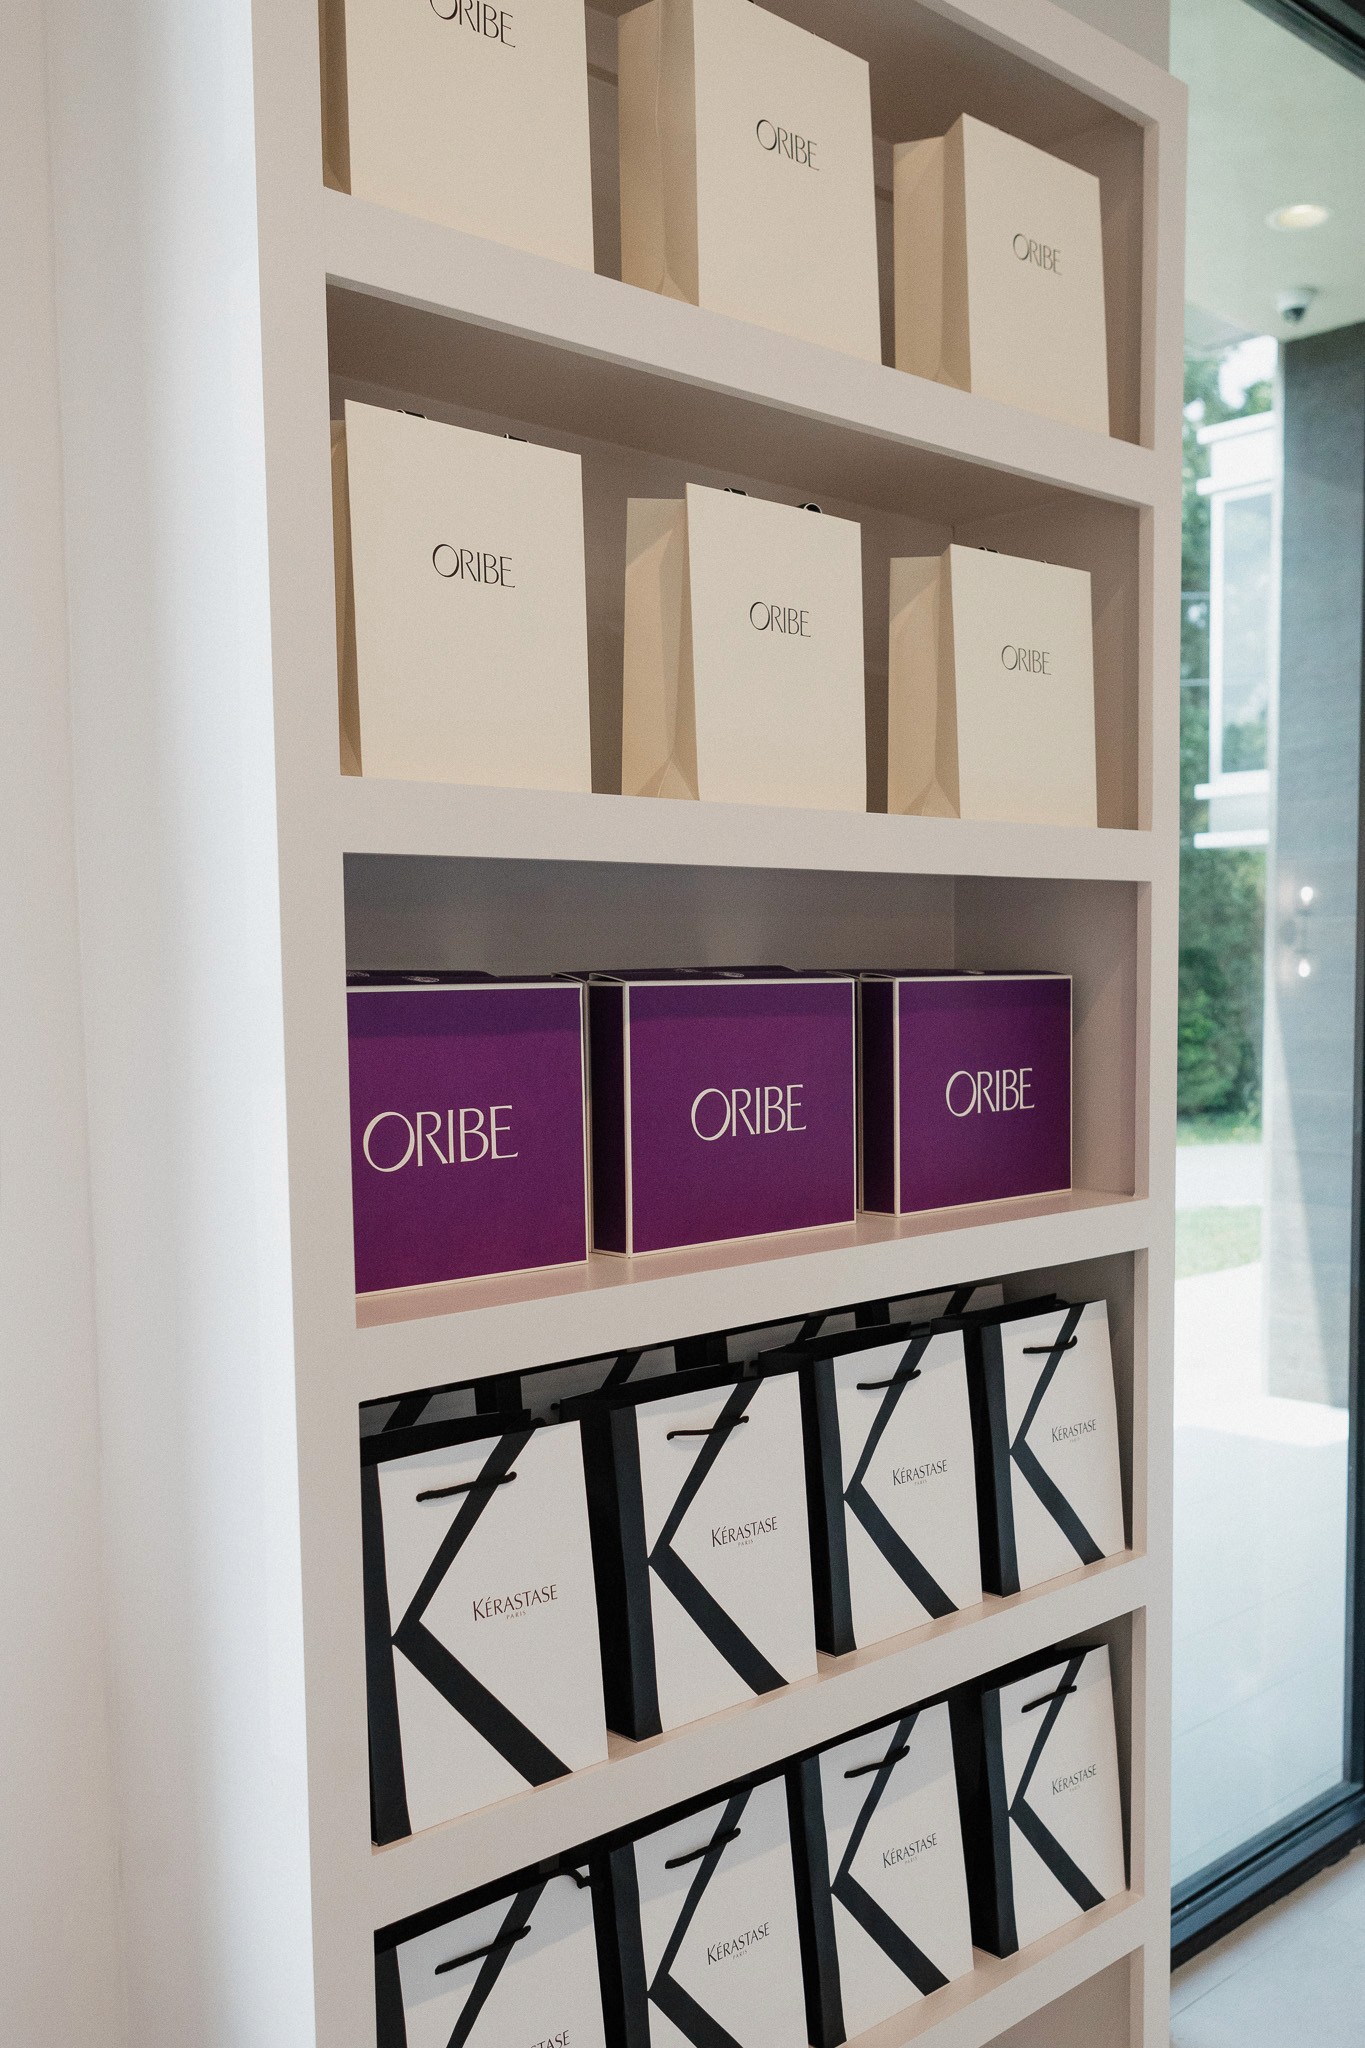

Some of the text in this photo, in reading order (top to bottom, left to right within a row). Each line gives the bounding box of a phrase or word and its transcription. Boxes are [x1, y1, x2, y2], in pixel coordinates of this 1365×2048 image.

[430, 0, 516, 48] ORIBE
[756, 119, 820, 171] ORIBE
[1013, 233, 1062, 276] ORIBE
[432, 543, 516, 588] ORIBE
[750, 601, 811, 637] ORIBE
[1001, 645, 1052, 675] ORIBE
[945, 1067, 1035, 1117] ORIBE
[691, 1083, 807, 1141] ORIBE
[363, 1104, 519, 1173] ORIBE
[1052, 1419, 1097, 1443] KÉRASTASE
[893, 1459, 948, 1486] KÉRASTASE
[711, 1516, 778, 1547] KÉRASTASE
[472, 1584, 558, 1621] KÉRASTASE
[506, 1610, 527, 1620] PARIS
[1052, 1763, 1097, 1795] KÉRASTASE
[882, 1832, 938, 1869] KÉRASTASE
[707, 1921, 770, 1966] KÉRASTASE
